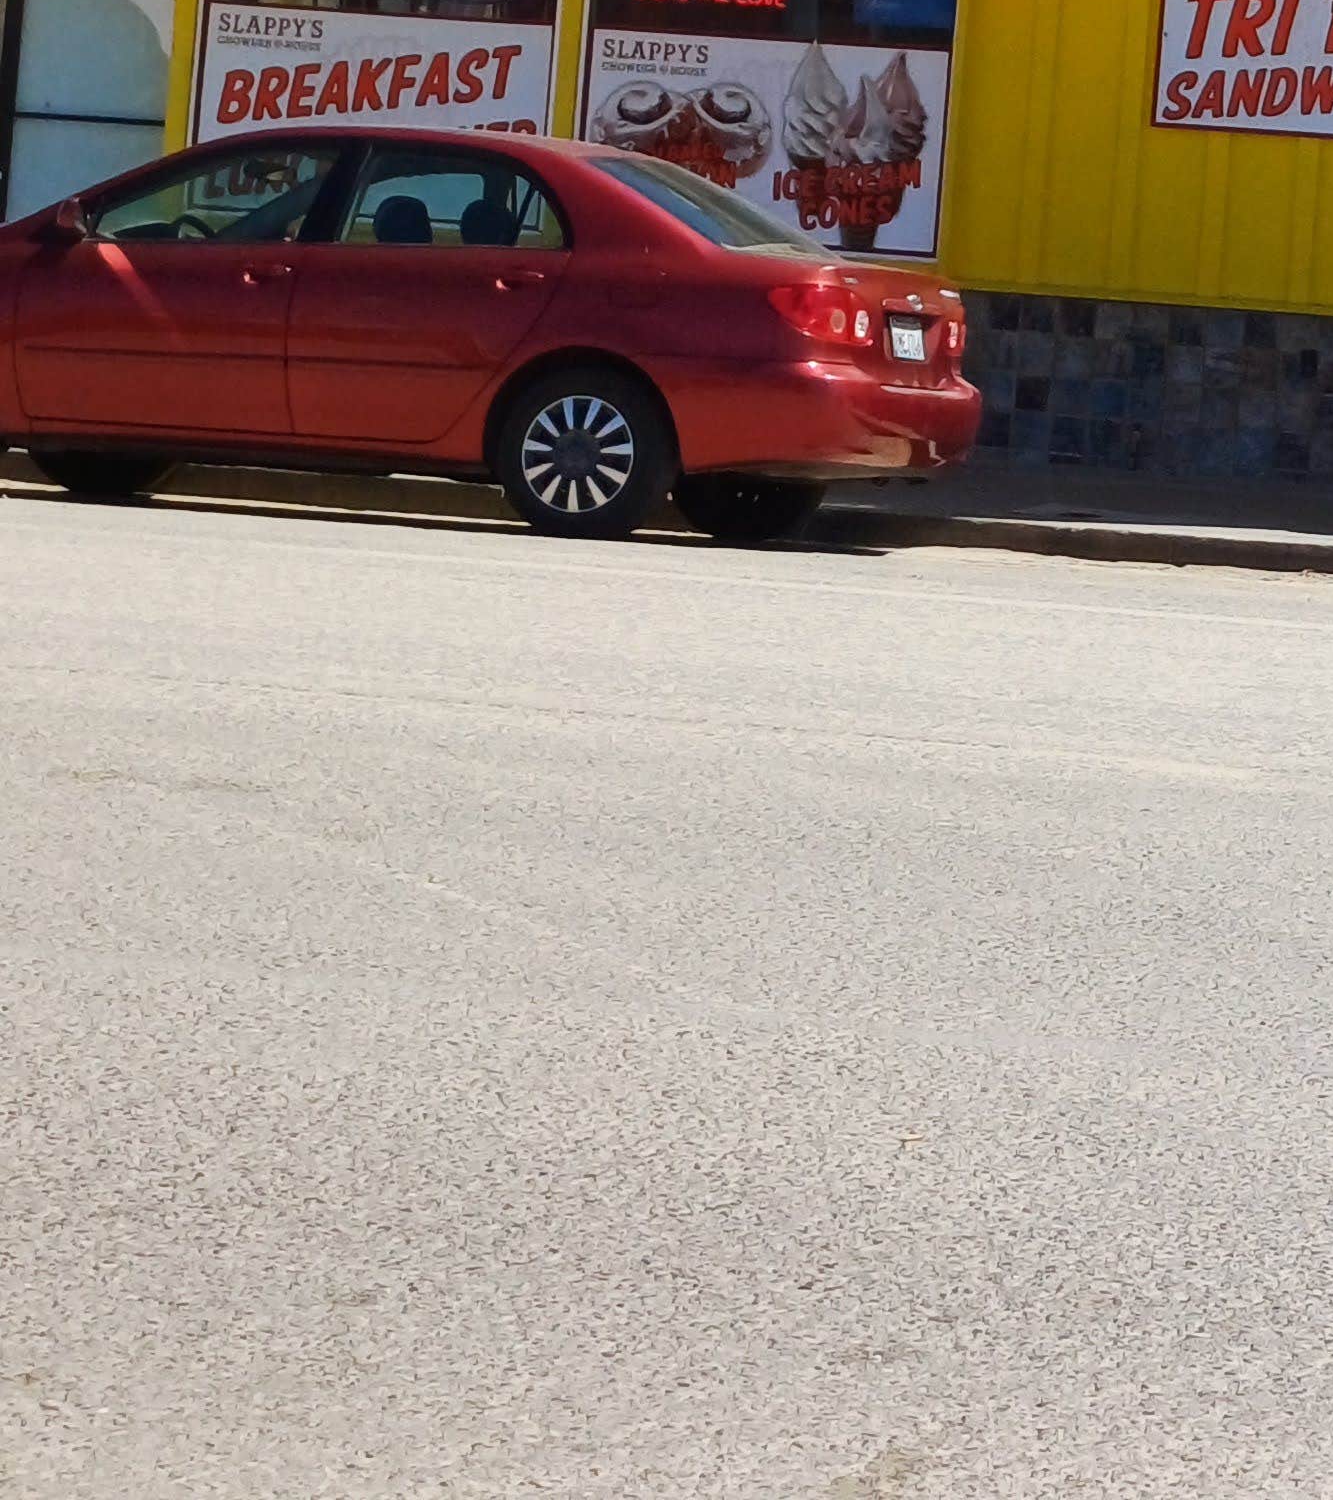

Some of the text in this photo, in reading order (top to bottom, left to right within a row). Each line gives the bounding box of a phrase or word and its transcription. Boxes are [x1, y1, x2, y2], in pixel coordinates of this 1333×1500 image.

[218, 12, 324, 39] SLAPPY'S
[602, 38, 709, 64] SLAPPY'S
[216, 44, 522, 125] BREAKFAST
[773, 167, 822, 201] ICE
[825, 158, 922, 197] CREAM
[799, 194, 894, 231] CONES
